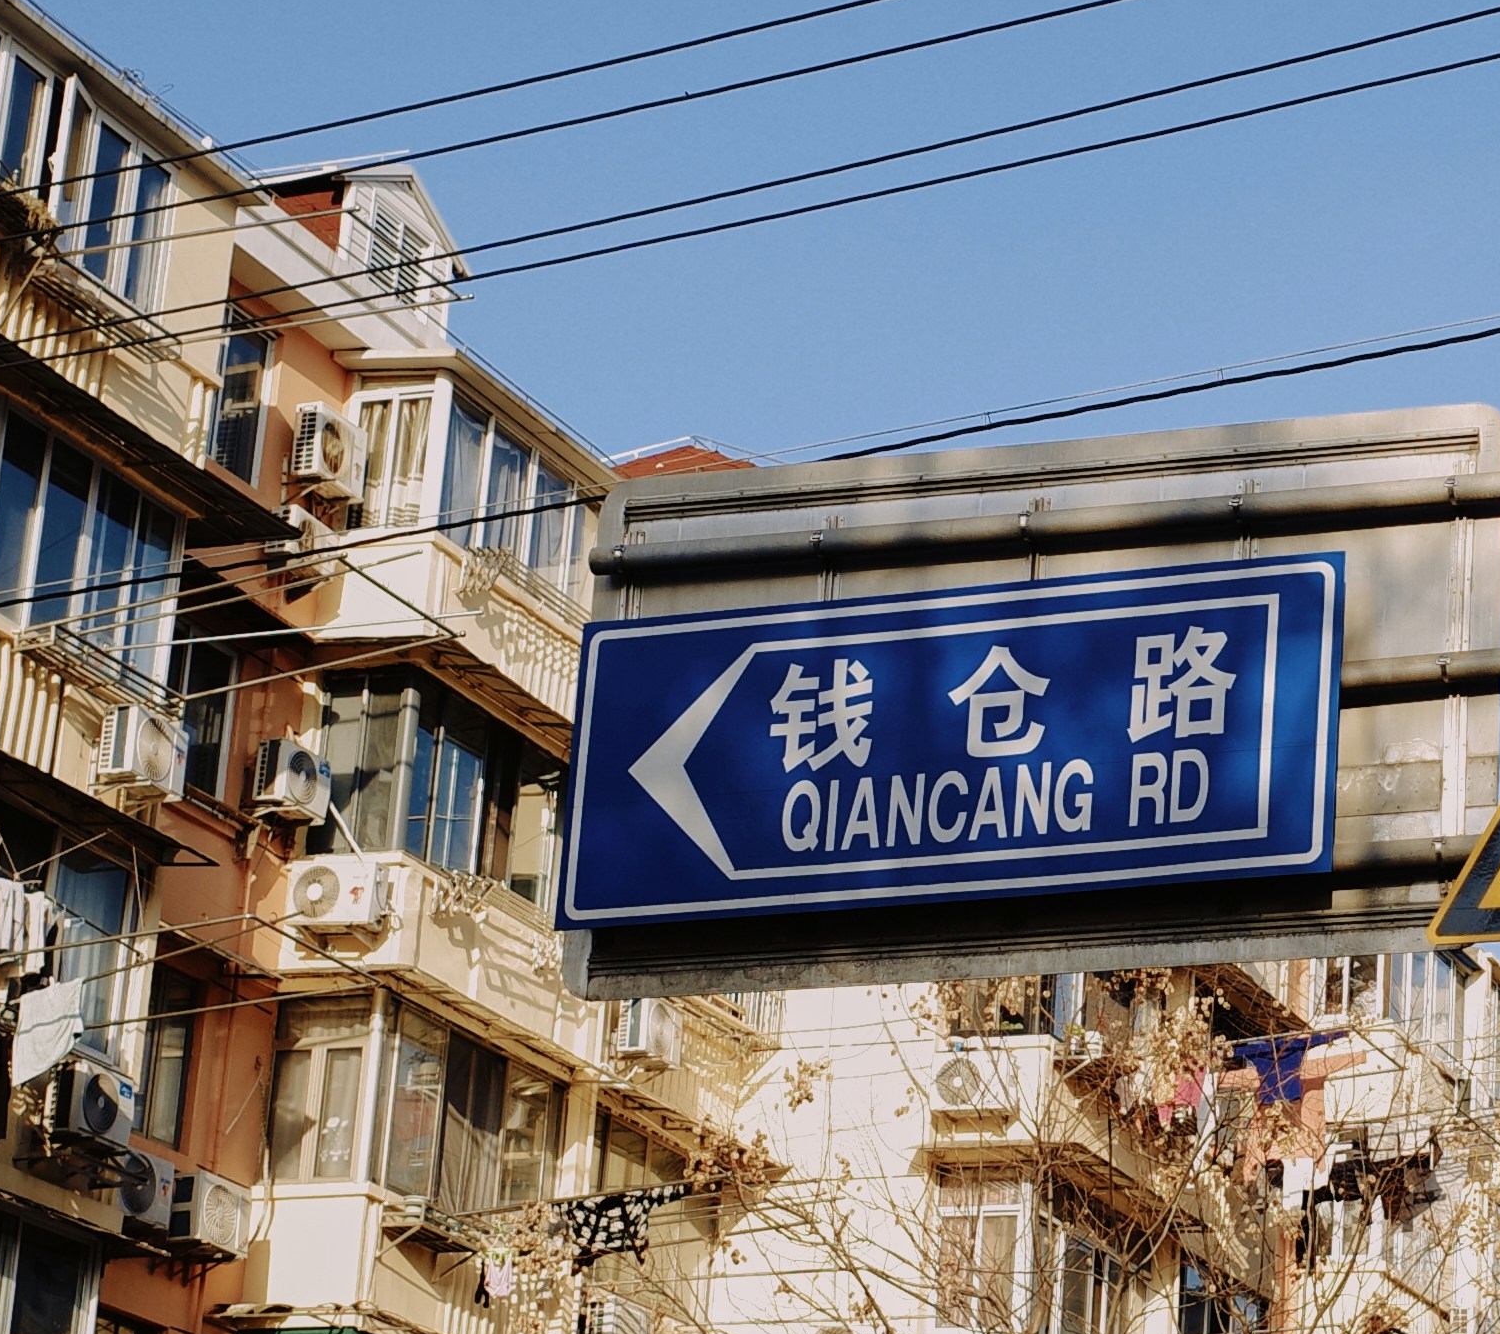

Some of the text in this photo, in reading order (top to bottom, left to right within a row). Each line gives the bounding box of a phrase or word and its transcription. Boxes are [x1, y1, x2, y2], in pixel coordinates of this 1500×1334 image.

[768, 623, 1237, 774] 钱仓路
[780, 746, 1210, 854] QIANCANG RD
